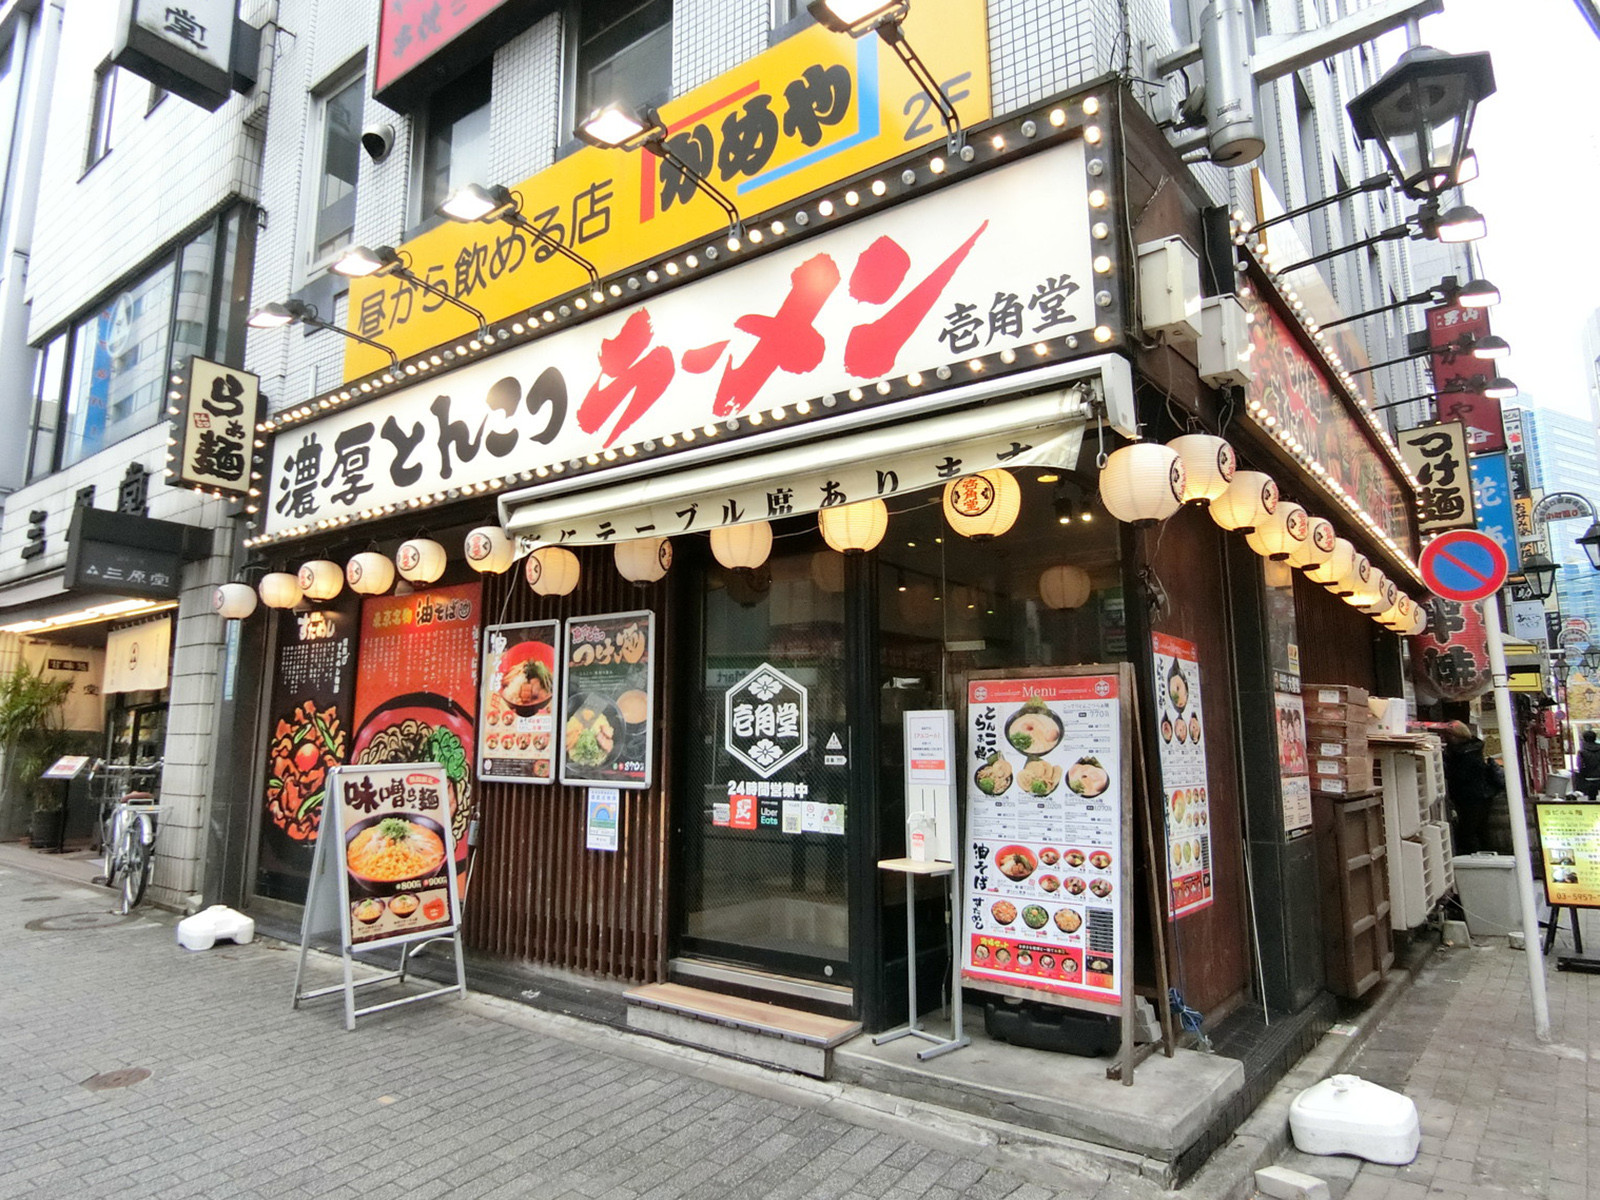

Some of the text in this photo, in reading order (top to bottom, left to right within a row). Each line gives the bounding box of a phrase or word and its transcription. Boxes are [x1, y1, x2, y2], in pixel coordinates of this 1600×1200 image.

[357, 63, 972, 345] 昼から飲める店 かめや 2F
[275, 366, 568, 519] 濃厚とんこつ
[576, 219, 989, 450] ラーメン
[937, 273, 1081, 355] 壱角堂
[191, 373, 246, 482] らぁ麺
[1407, 432, 1465, 524] つけ麺
[103, 567, 170, 587] 三原堂
[416, 594, 458, 627] 油そば
[1022, 686, 1057, 698] Menu
[733, 702, 800, 737] 壱角堂
[344, 775, 440, 814] 味噌らぁ麺
[728, 780, 809, 799] 24時間営業中
[761, 807, 778, 817] Uber
[761, 816, 779, 825] Eats
[973, 842, 990, 891] 油そば
